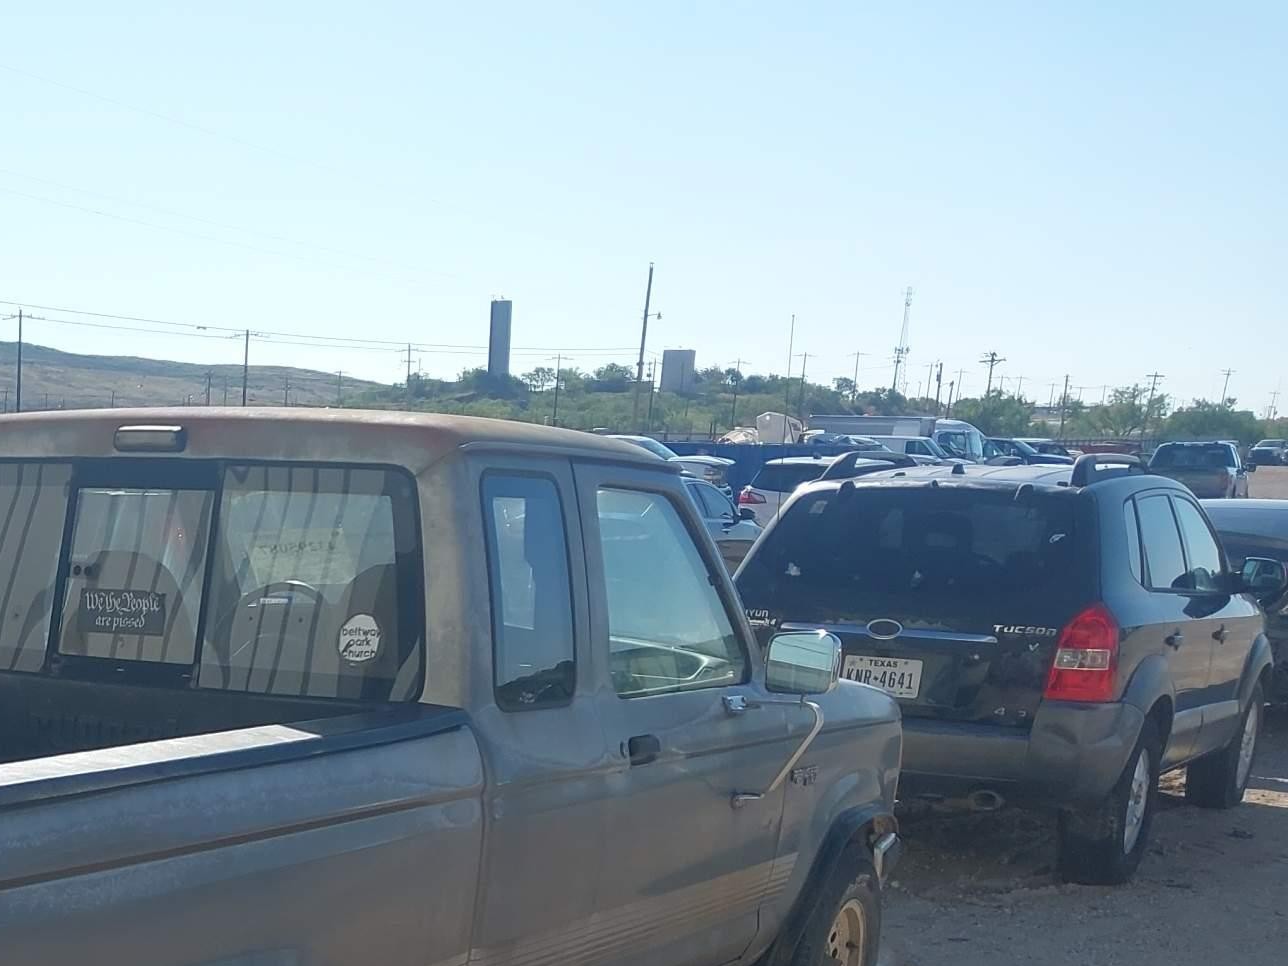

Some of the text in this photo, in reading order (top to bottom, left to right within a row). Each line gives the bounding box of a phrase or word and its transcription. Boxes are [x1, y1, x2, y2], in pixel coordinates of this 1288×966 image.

[120, 591, 161, 616] People
[95, 613, 145, 632] are pissed
[993, 623, 1057, 636] TUCSON
[343, 637, 371, 653] park
[343, 649, 376, 659] church
[869, 658, 898, 669] TEXAS
[879, 670, 913, 690] 4641
